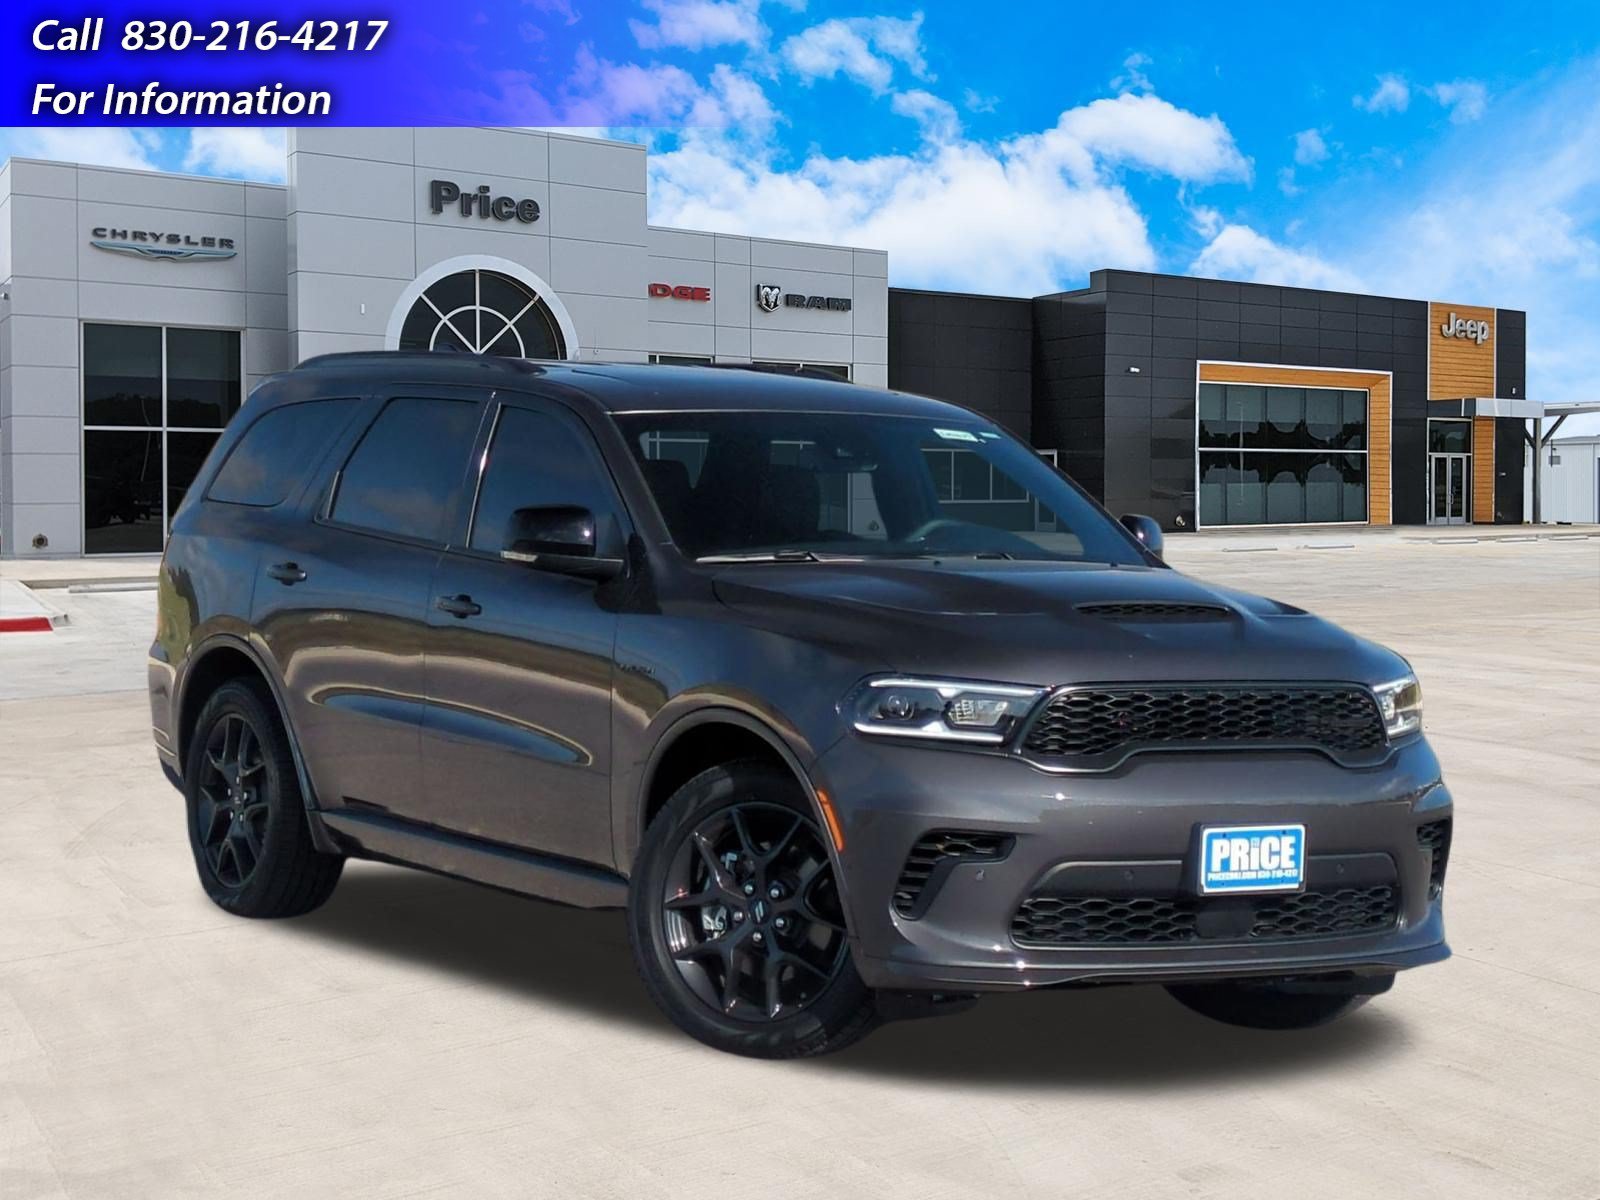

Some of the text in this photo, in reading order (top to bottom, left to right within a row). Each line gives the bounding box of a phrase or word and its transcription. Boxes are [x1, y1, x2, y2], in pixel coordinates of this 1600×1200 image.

[431, 179, 540, 223] Price
[92, 227, 234, 249] CHRYSLER
[648, 283, 711, 302] DGE
[785, 293, 852, 312] RAM
[1441, 312, 1489, 345] Jeep
